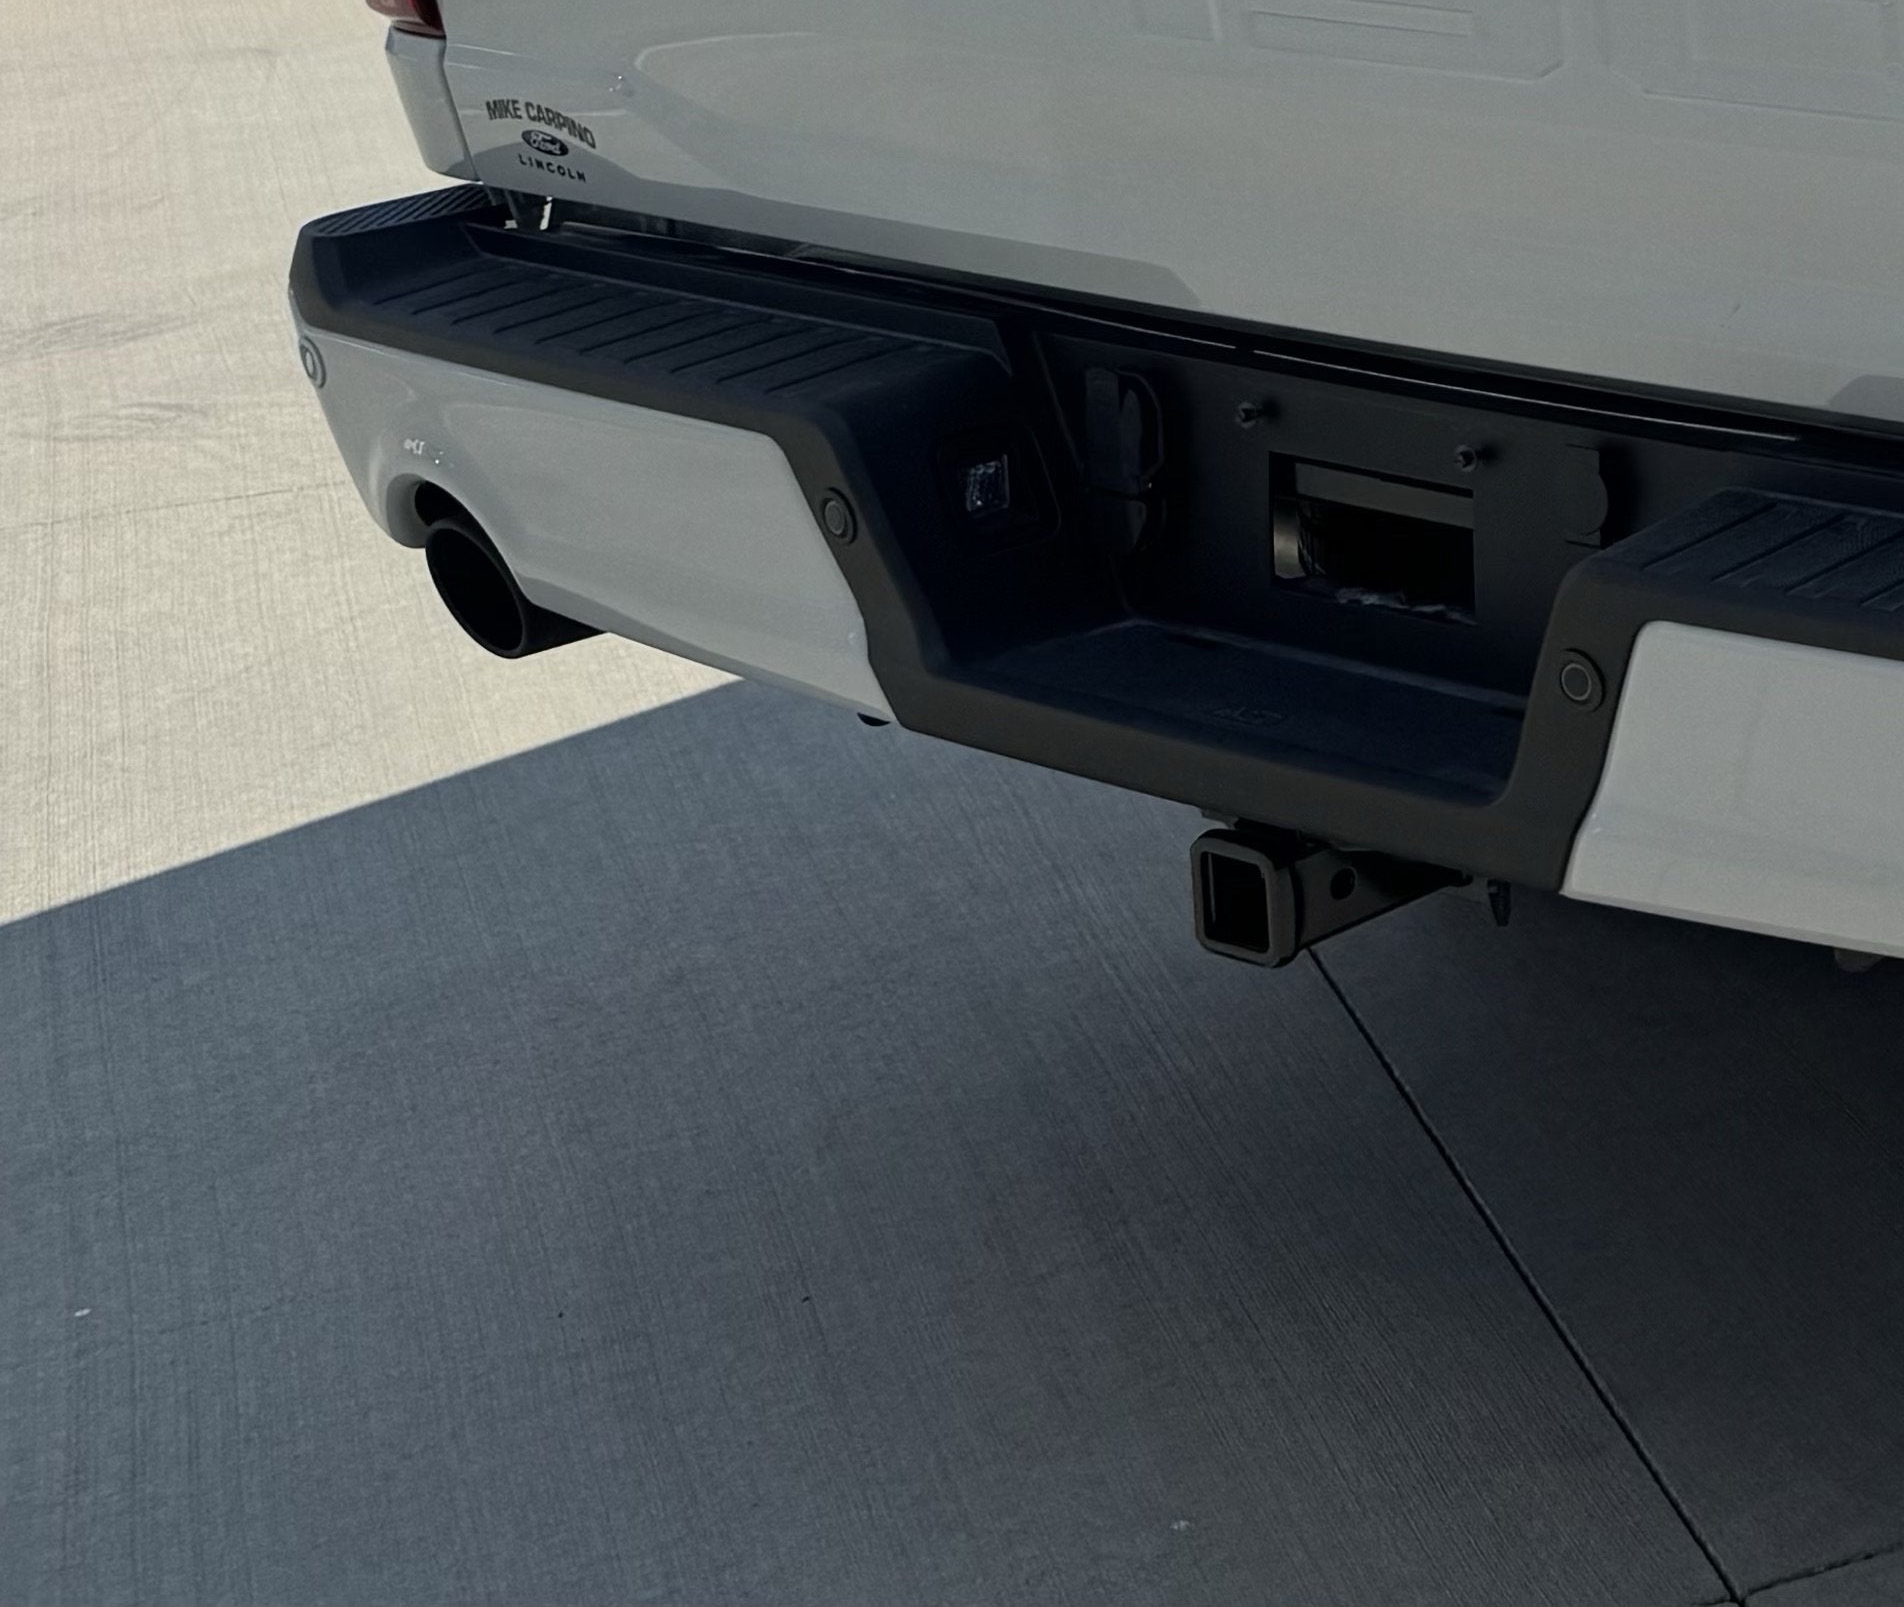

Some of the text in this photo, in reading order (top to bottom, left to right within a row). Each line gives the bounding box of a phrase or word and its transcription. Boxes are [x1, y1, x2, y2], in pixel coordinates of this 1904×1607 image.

[486, 99, 596, 149] MIKE CARPINO
[518, 154, 586, 182] LINCOLN
